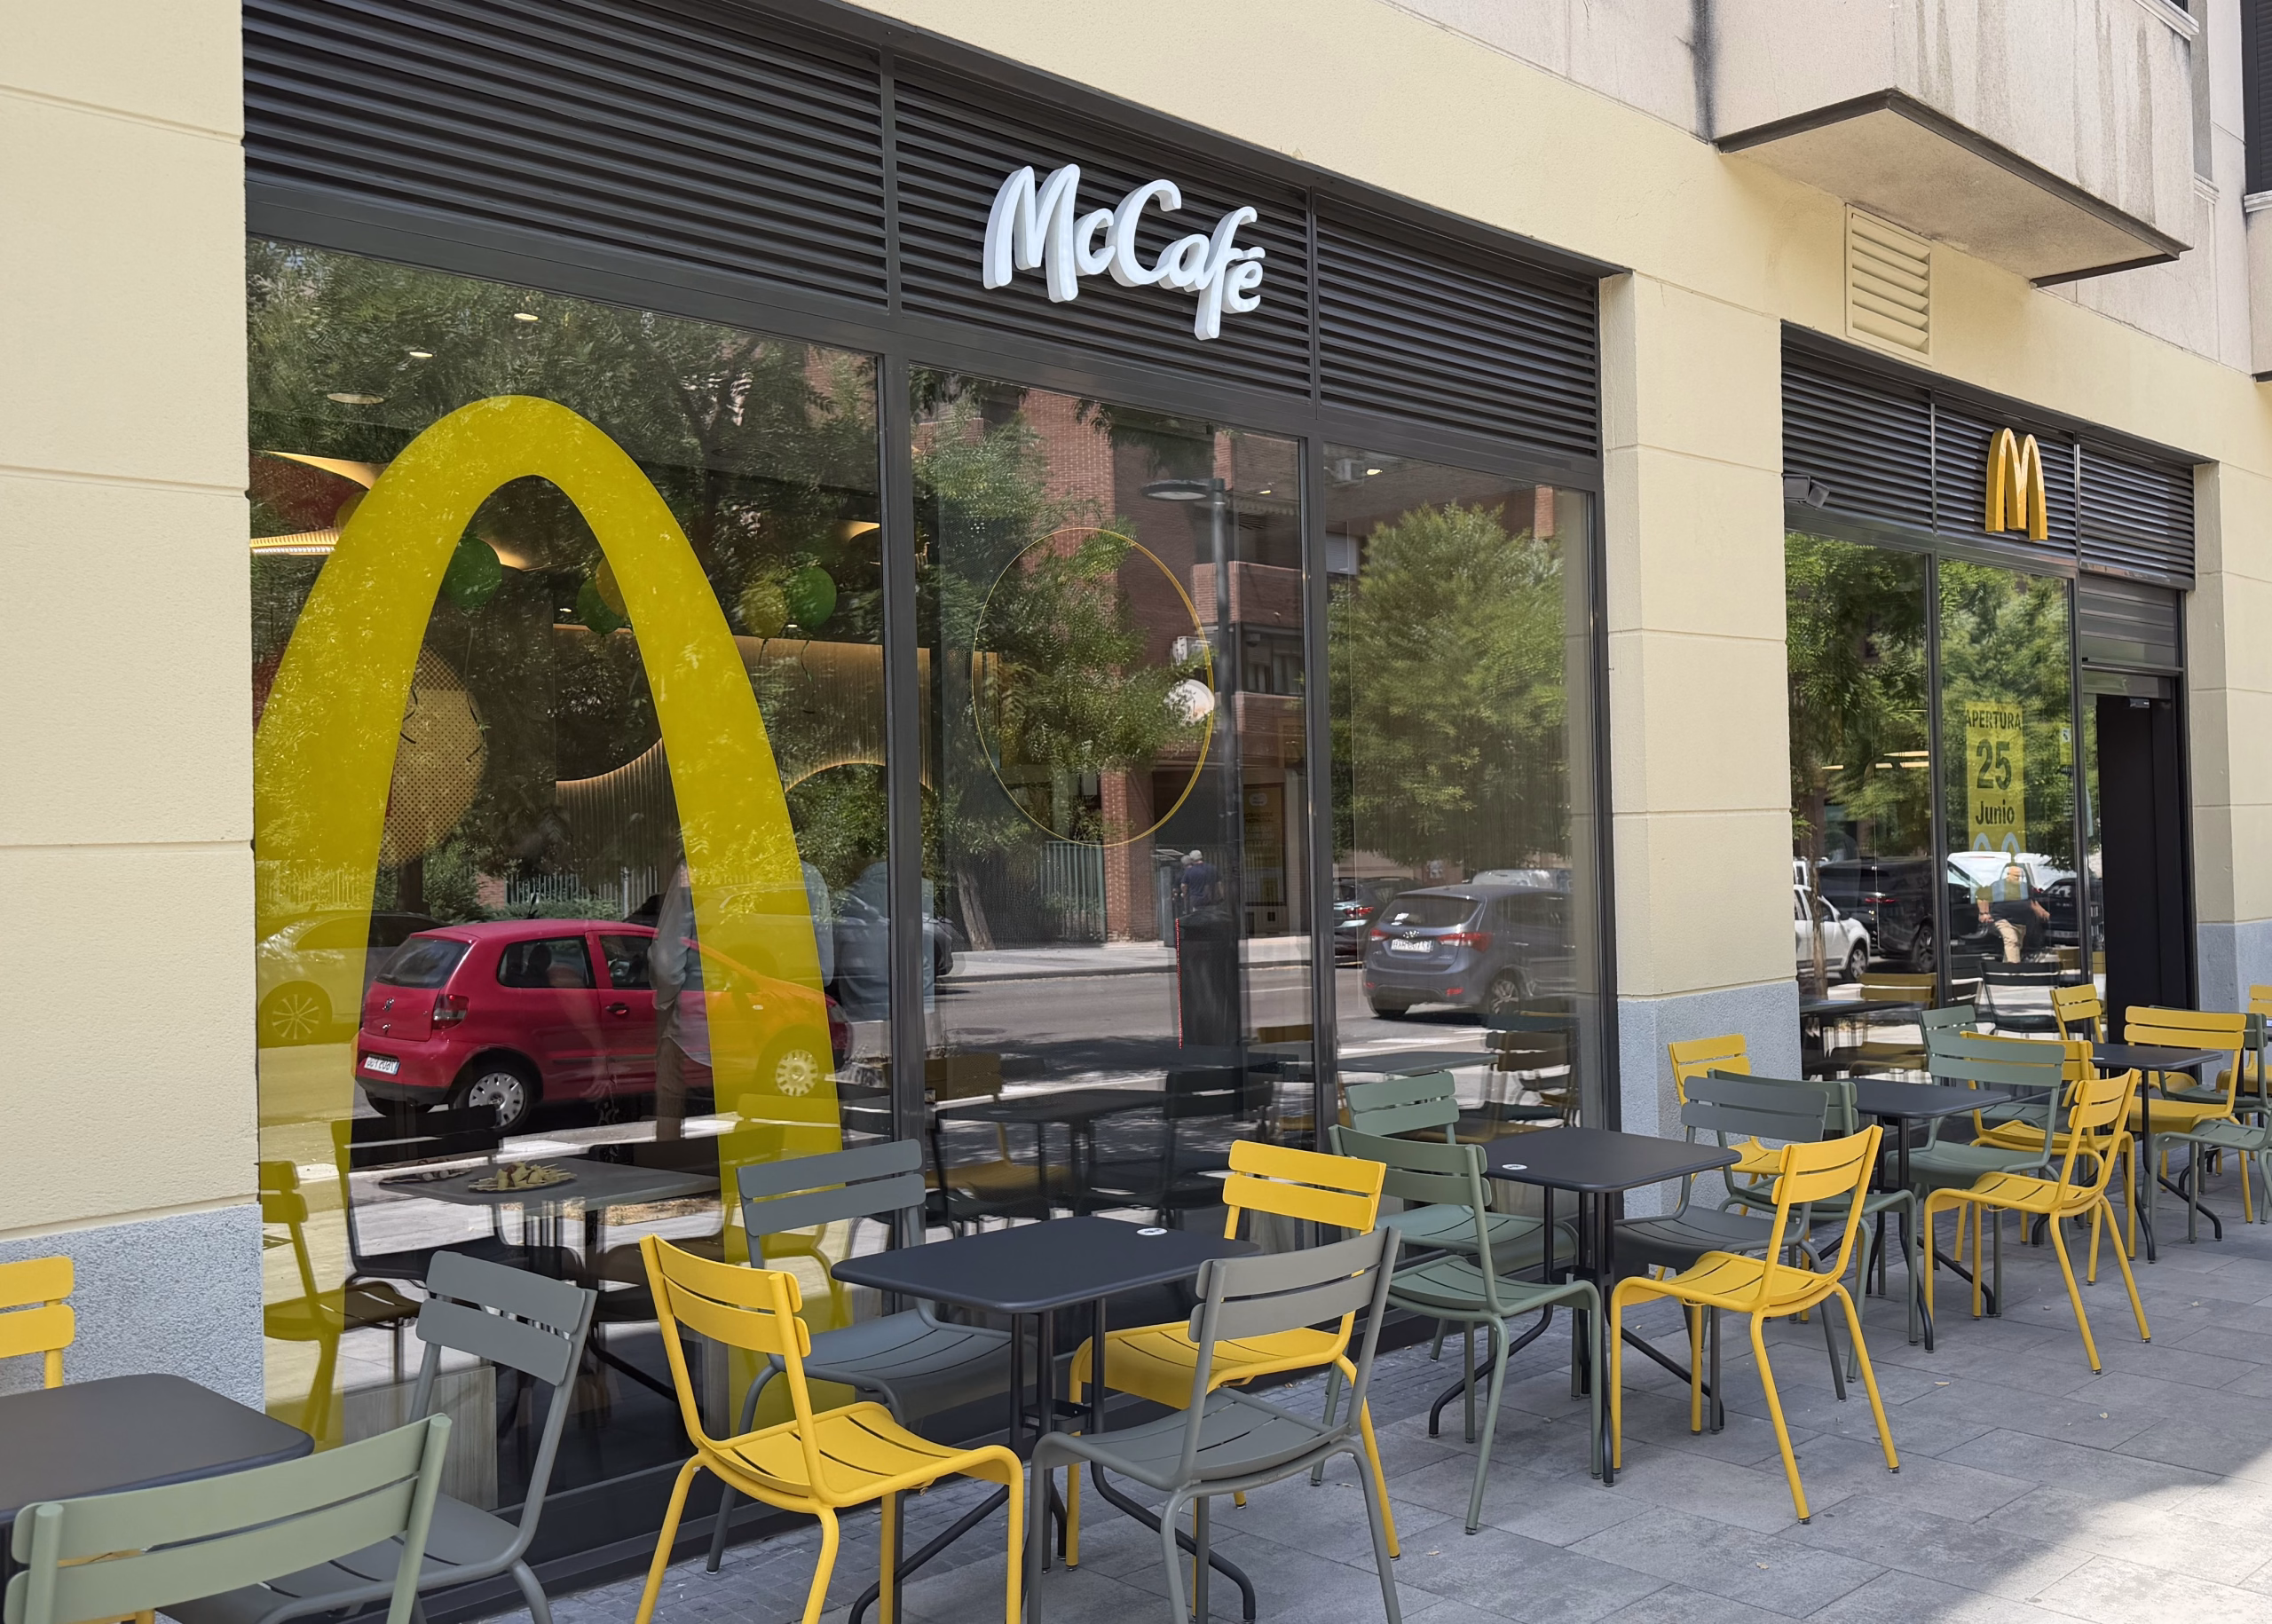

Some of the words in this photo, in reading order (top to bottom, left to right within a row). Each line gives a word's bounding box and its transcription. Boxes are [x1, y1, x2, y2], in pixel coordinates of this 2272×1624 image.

[1966, 709, 2022, 730] APERTURA
[1976, 738, 2012, 791] 25
[1976, 799, 2015, 825] Junio
